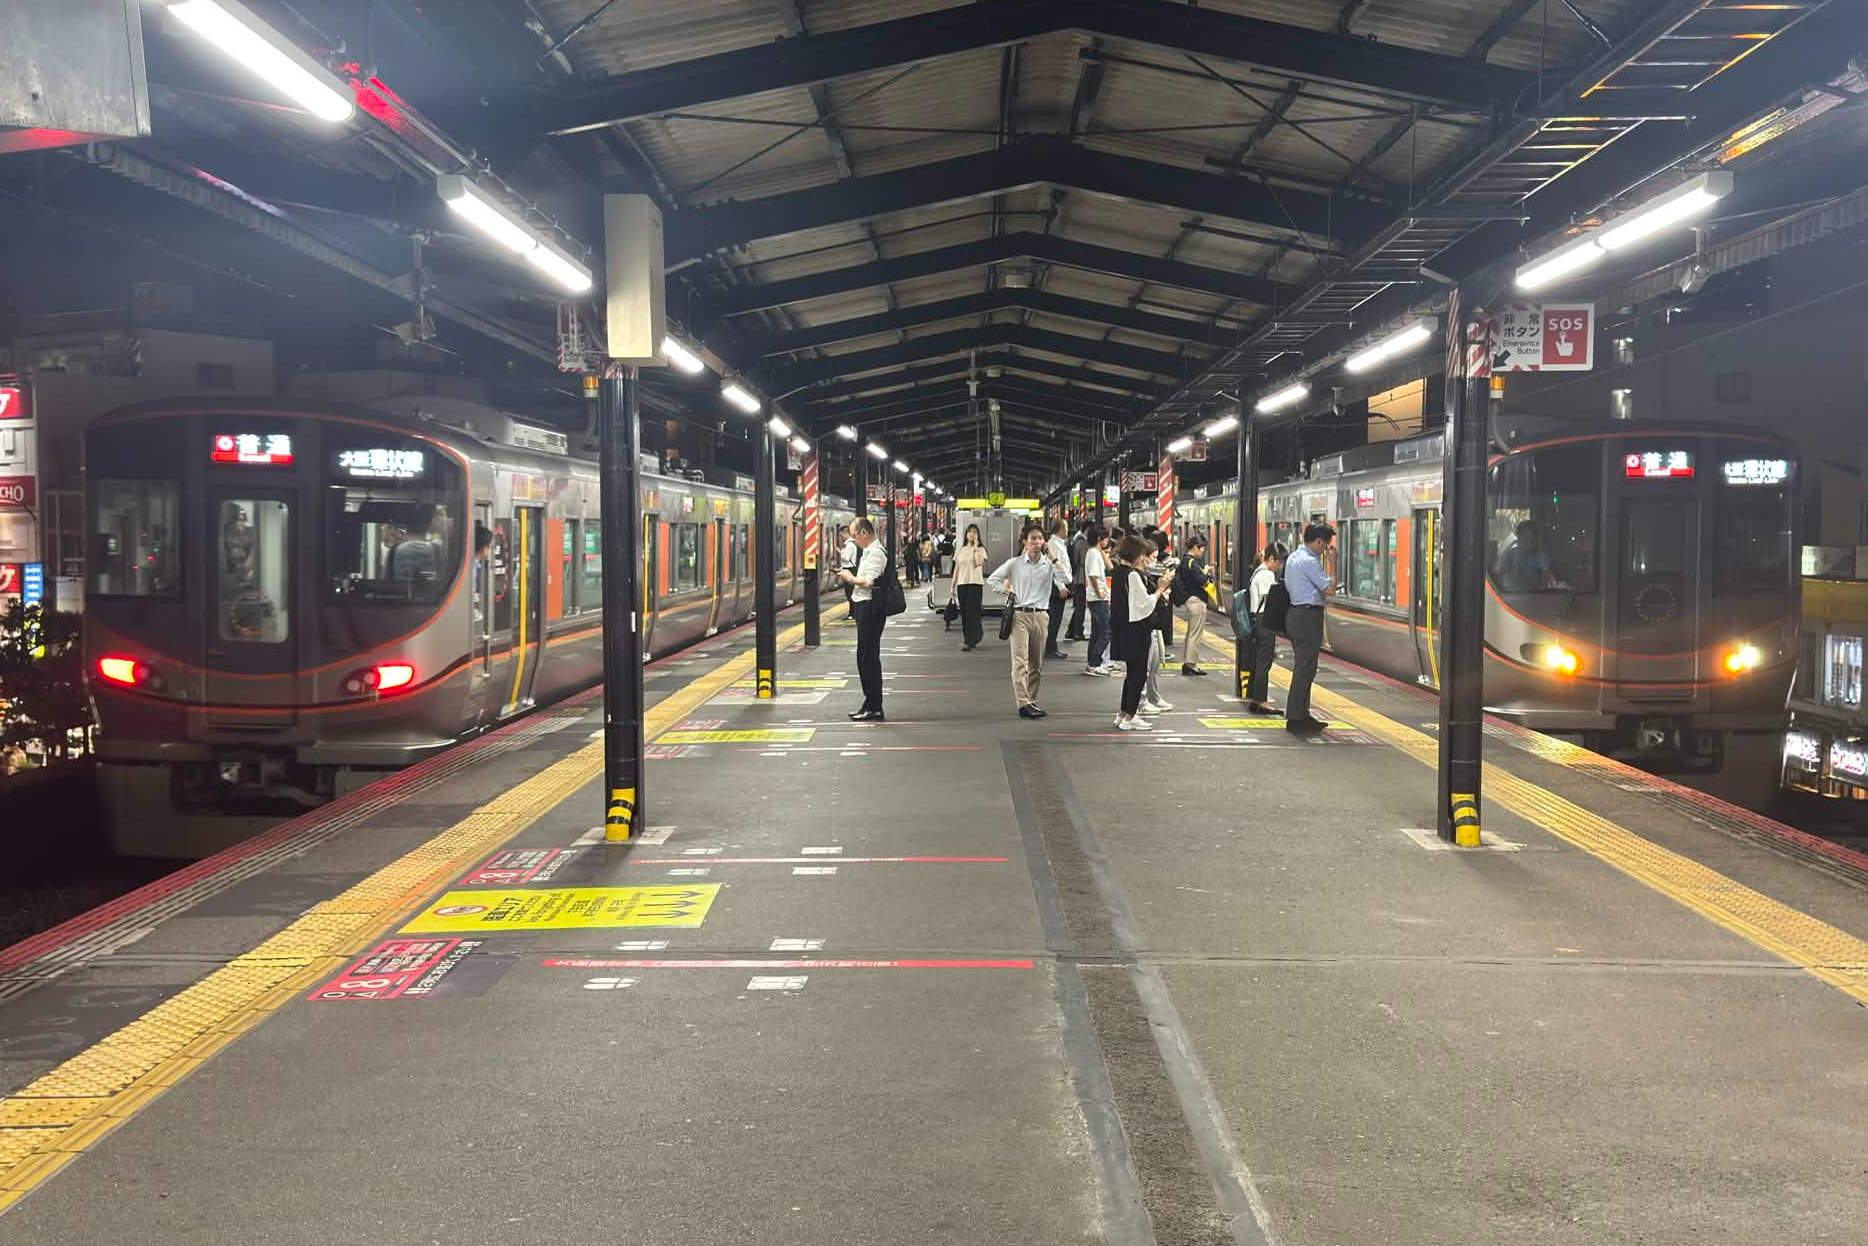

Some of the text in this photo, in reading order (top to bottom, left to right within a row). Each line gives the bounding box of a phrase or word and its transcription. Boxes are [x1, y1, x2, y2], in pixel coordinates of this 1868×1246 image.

[1548, 318, 1584, 331] SOS
[1503, 327, 1541, 338] ボタン
[1503, 340, 1540, 348] Emergency
[1517, 347, 1540, 355] Button
[340, 978, 392, 989] 8
